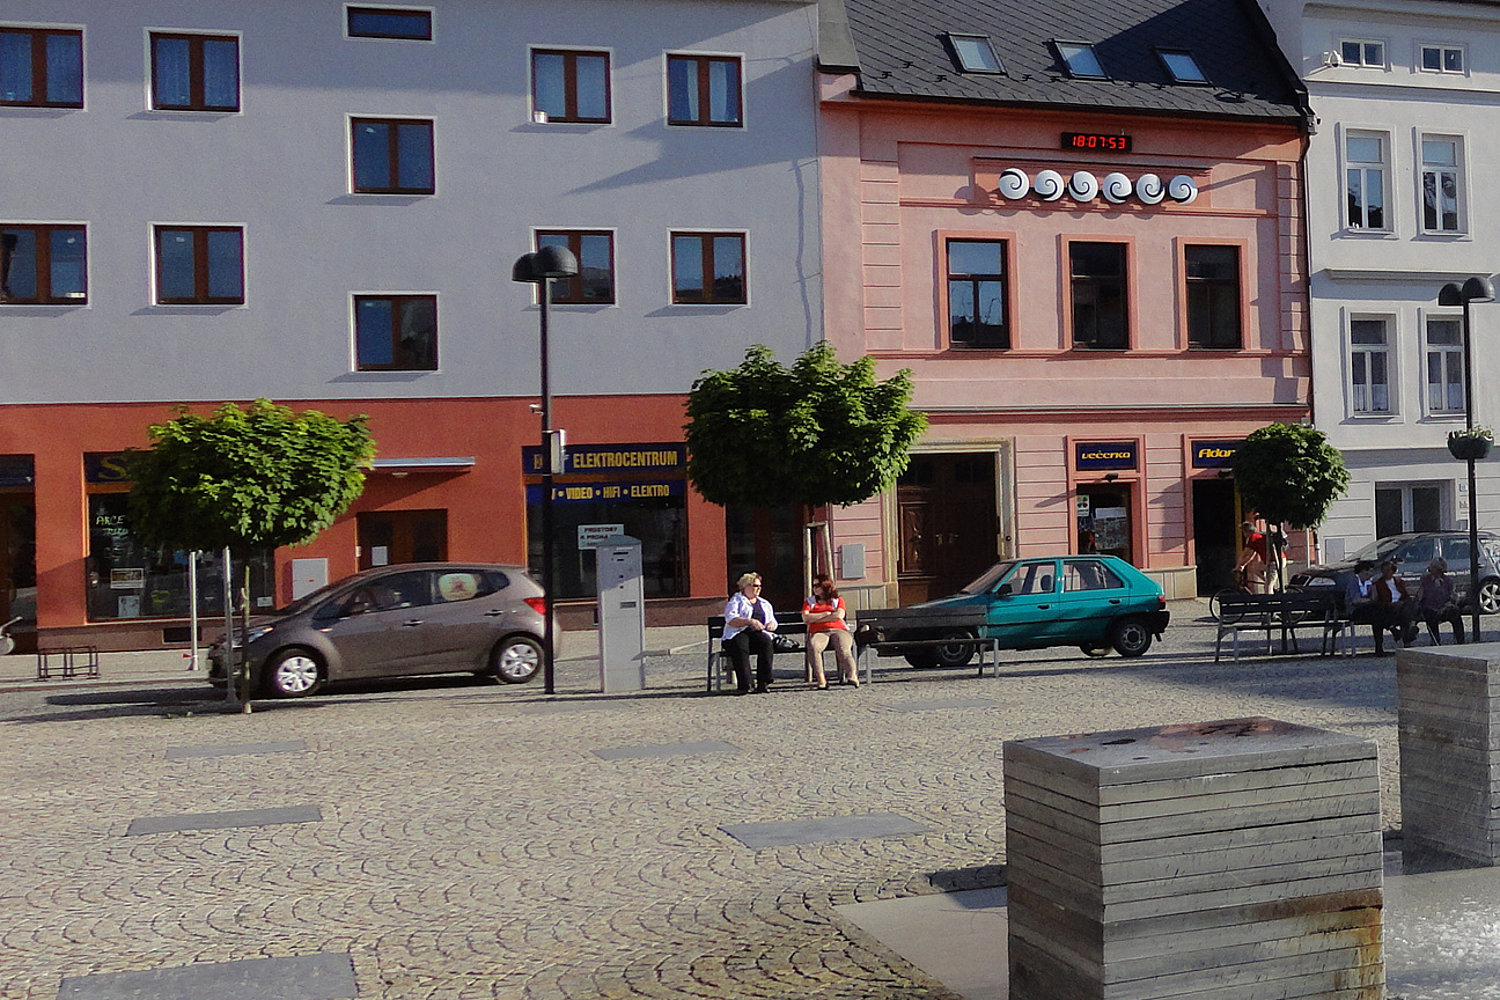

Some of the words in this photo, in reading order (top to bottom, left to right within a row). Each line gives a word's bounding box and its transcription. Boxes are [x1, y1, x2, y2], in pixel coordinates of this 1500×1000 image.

[1073, 135, 1126, 149] 18:07:53
[573, 451, 678, 468] ELEKTROCENTRUM
[566, 487, 594, 500] VIDEO
[603, 485, 621, 498] HIFI
[631, 484, 670, 498] ELEKTRO
